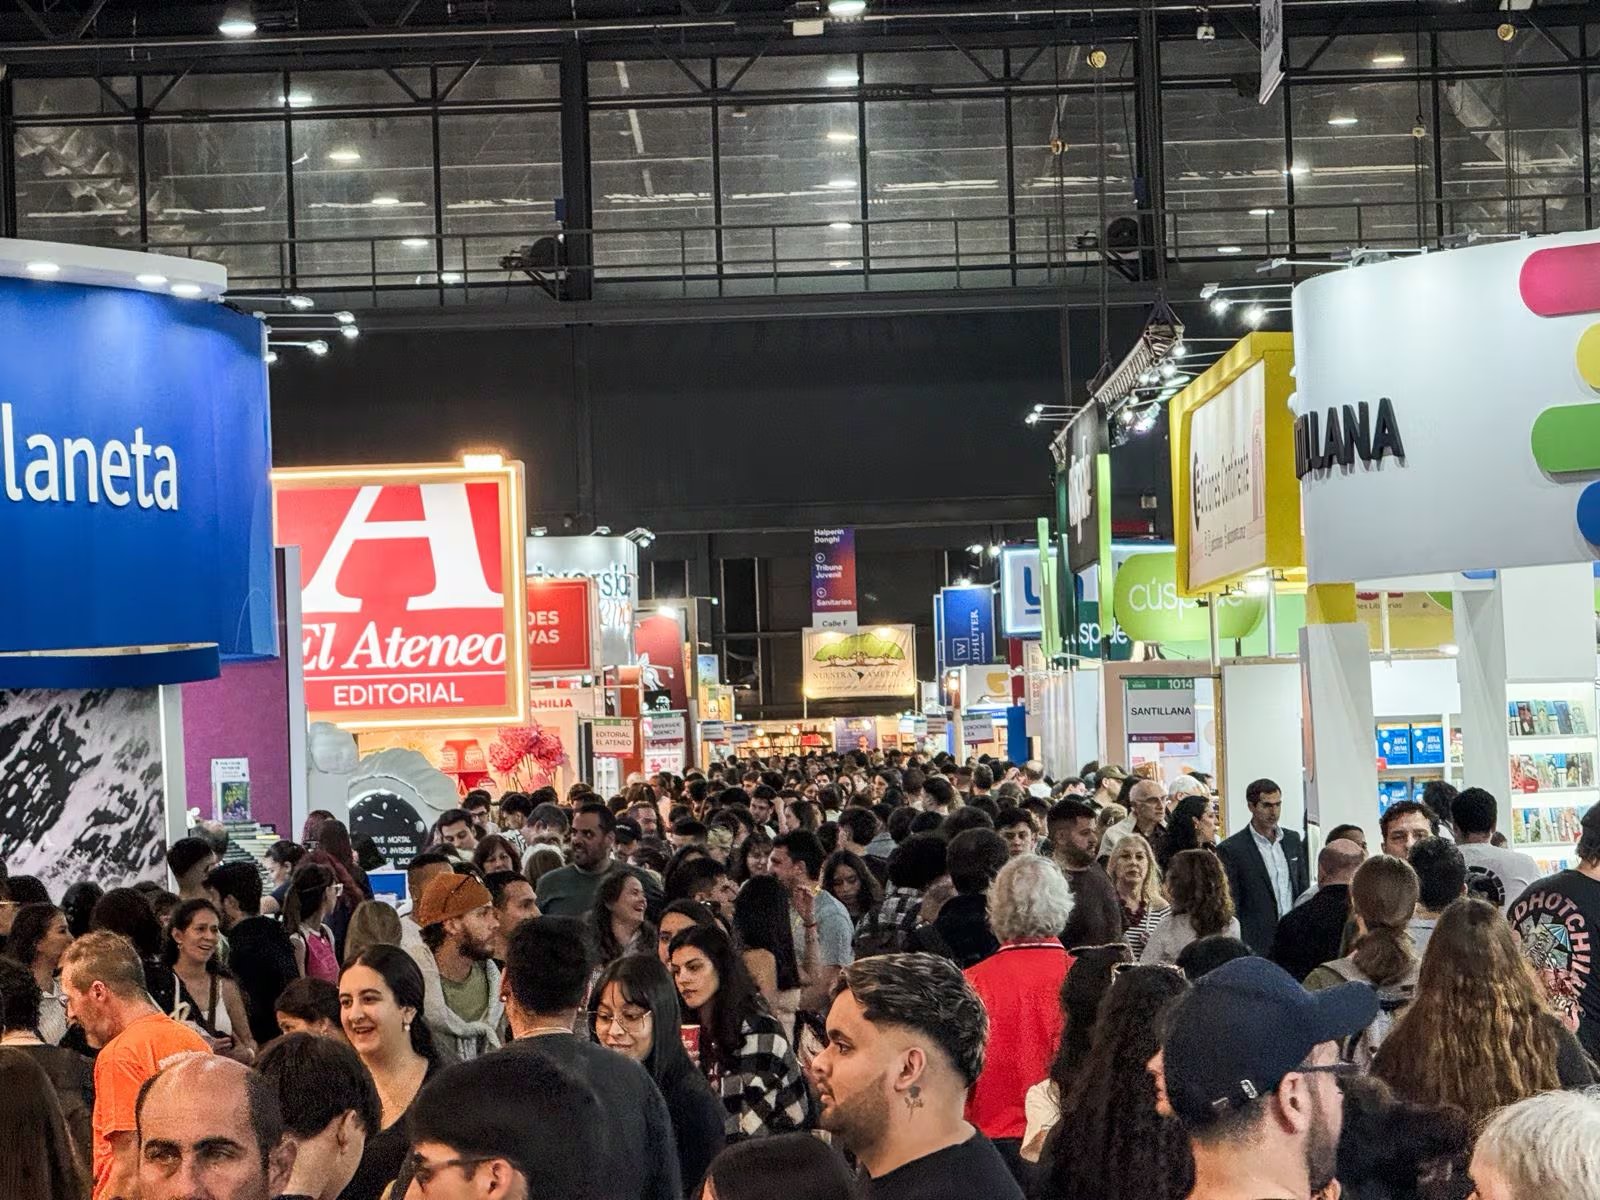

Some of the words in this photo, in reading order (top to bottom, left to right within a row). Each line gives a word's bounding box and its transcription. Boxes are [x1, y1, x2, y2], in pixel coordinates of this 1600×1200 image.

[2, 402, 178, 511] laneta
[814, 528, 845, 537] Halperin
[814, 536, 840, 544] Donghi
[302, 484, 505, 613] A
[302, 622, 337, 671] El
[341, 621, 507, 669] Ateneo
[1167, 679, 1193, 689] 1014
[333, 682, 464, 706] EDITORIAL
[1131, 707, 1191, 715] SANTILLANA
[387, 835, 412, 844] MORTAL
[389, 846, 417, 855] INVISIBLE
